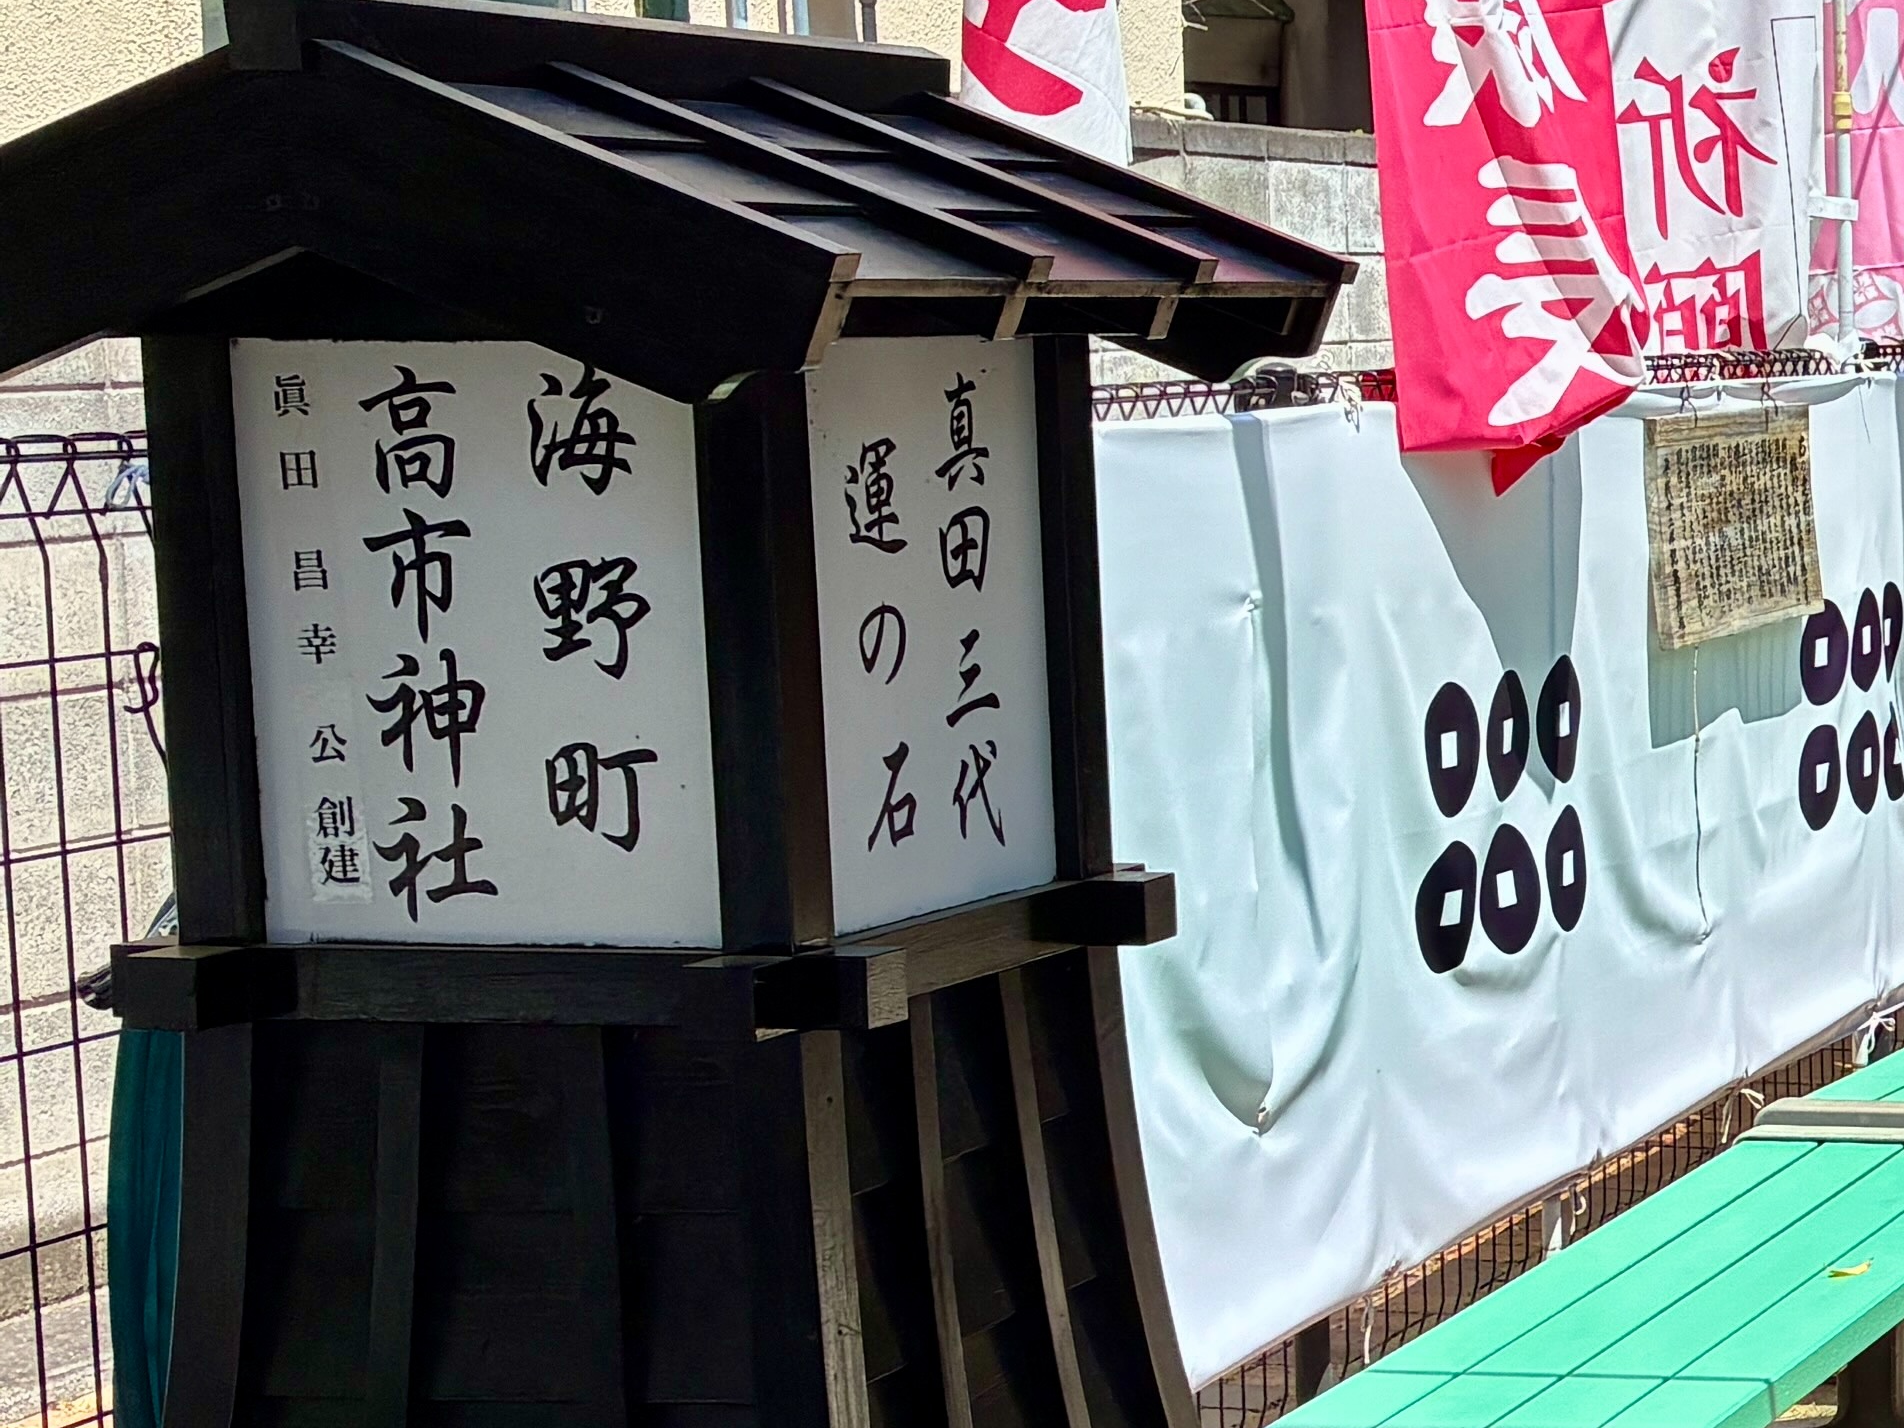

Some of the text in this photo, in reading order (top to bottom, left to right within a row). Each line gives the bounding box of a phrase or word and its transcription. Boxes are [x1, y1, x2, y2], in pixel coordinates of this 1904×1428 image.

[357, 364, 501, 924] 高市神社
[526, 361, 661, 855] 海野町
[843, 436, 921, 855] 運の石
[932, 371, 1008, 849] 真田三代
